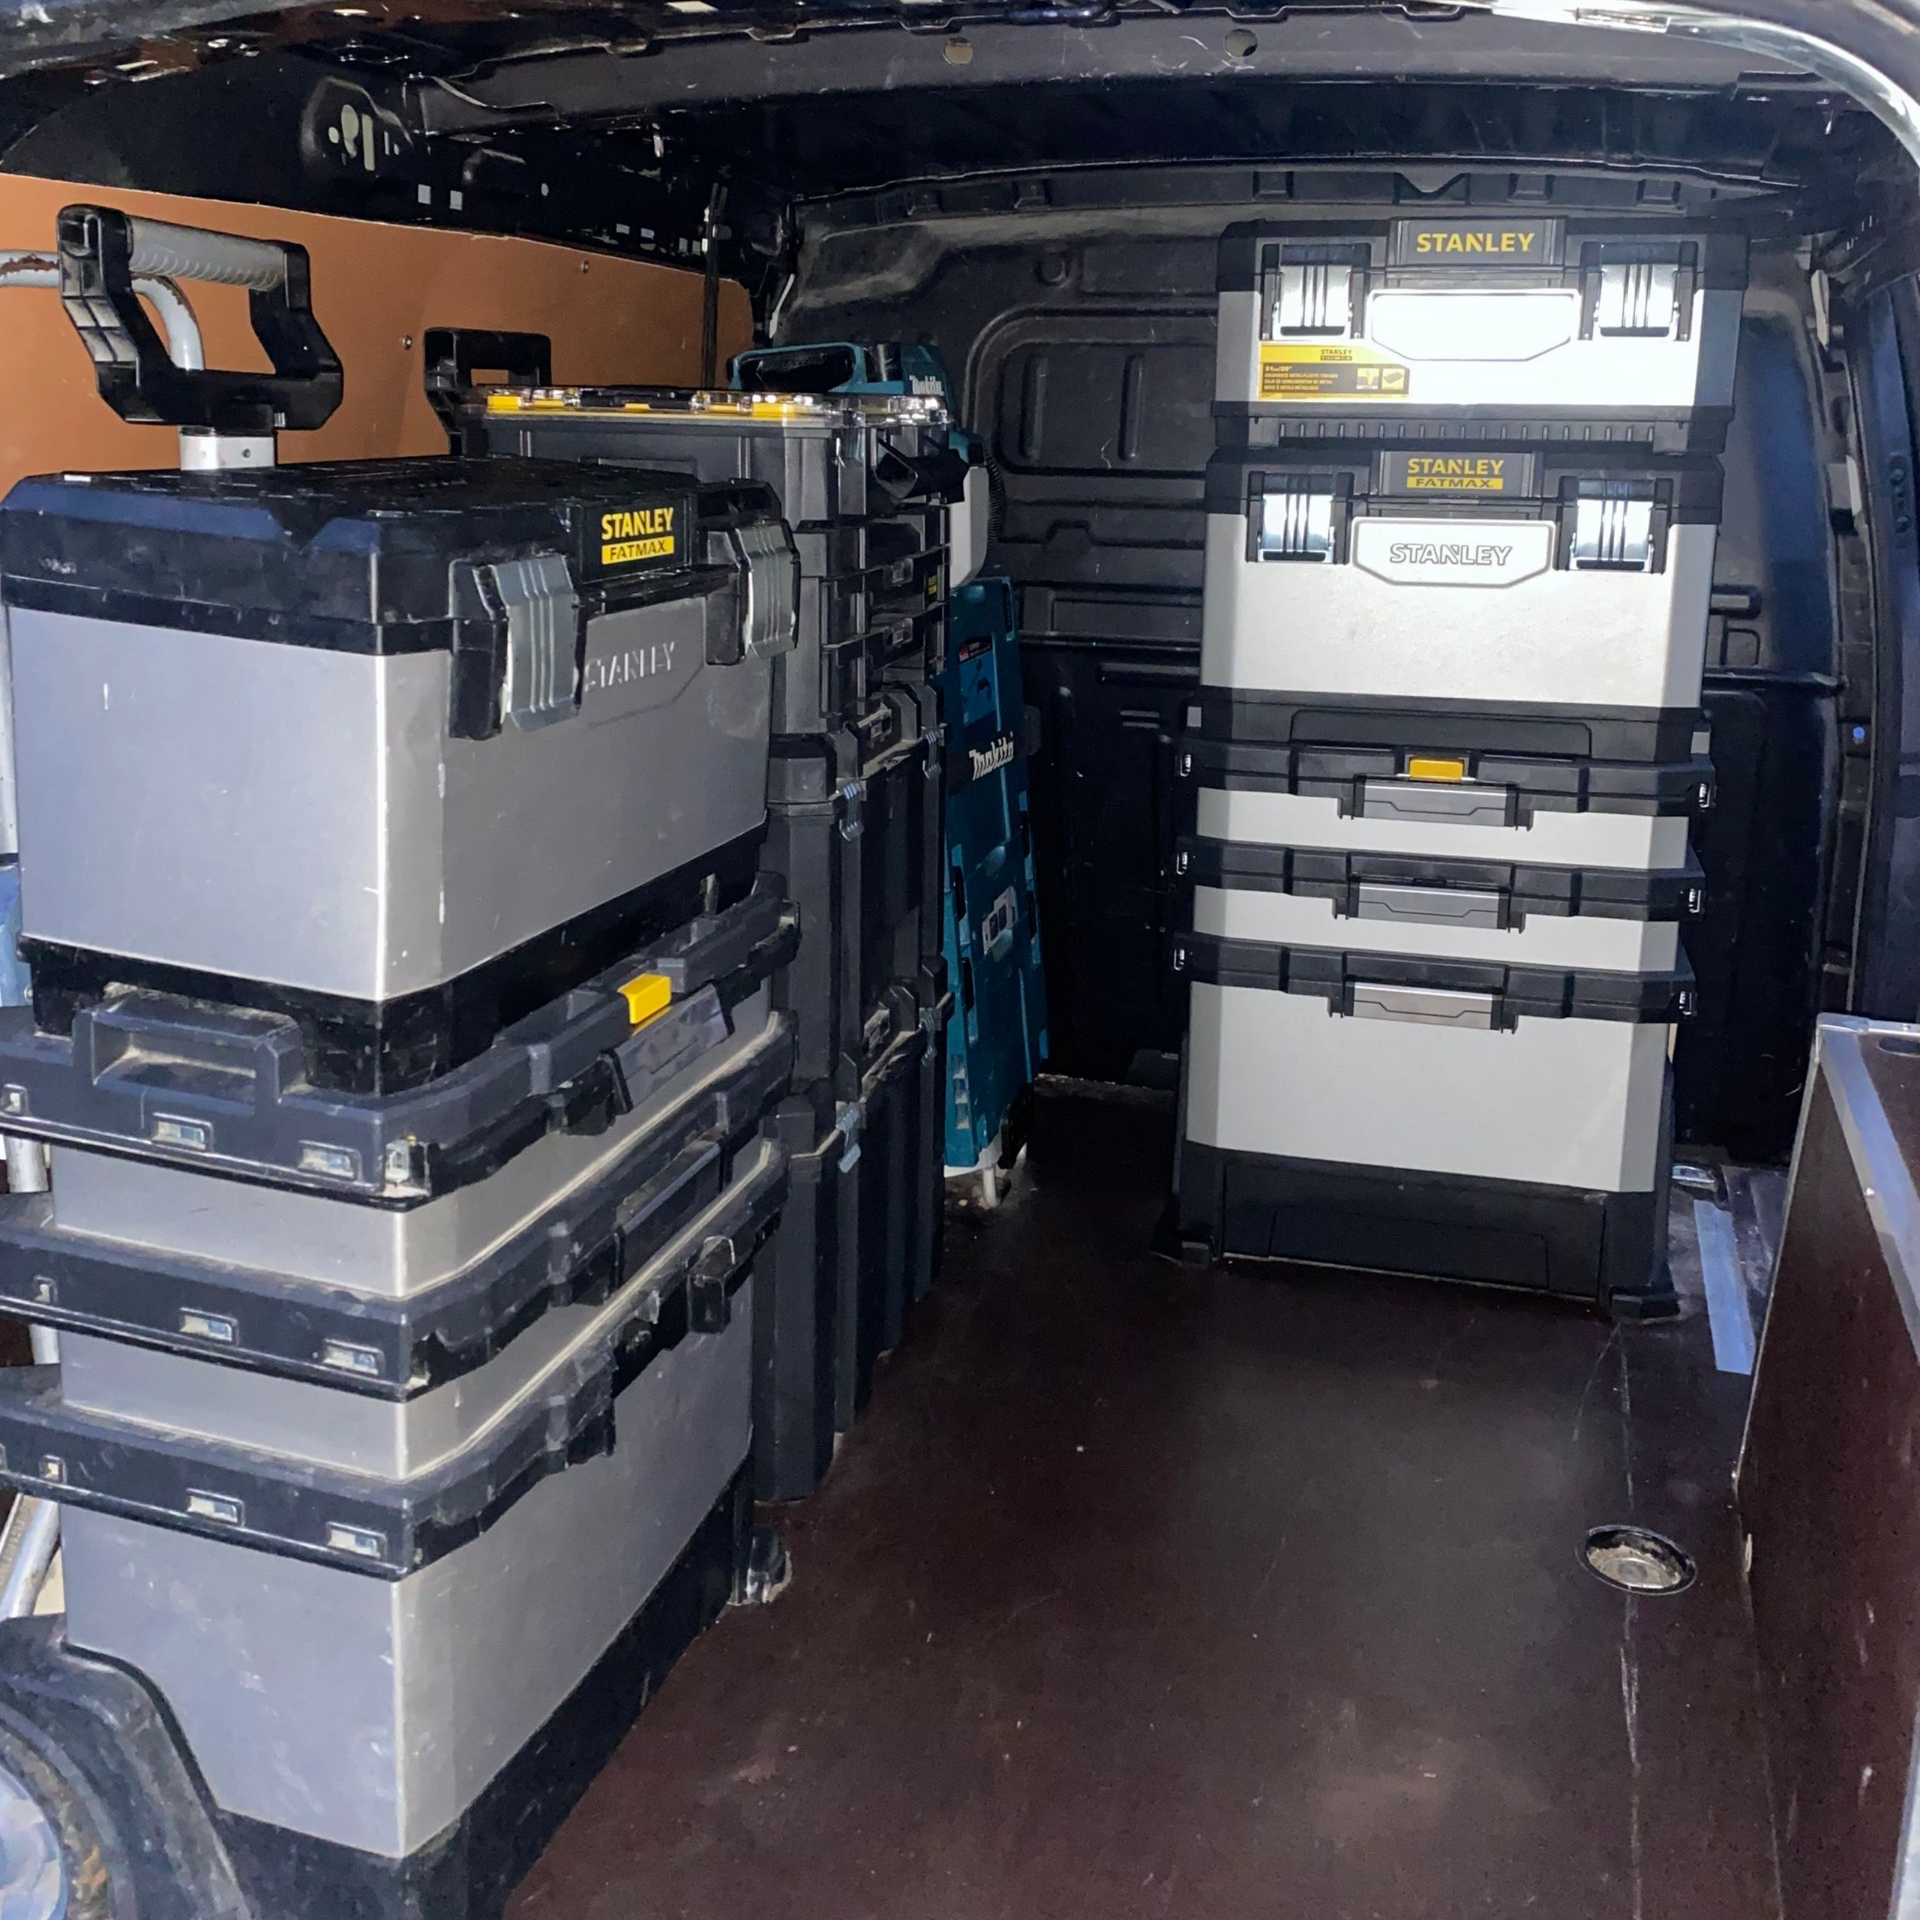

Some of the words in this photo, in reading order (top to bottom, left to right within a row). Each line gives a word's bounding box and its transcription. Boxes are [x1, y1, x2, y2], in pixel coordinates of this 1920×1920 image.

[1416, 231, 1535, 253] STANLEY
[1407, 458, 1505, 476] STANLEY
[1416, 478, 1492, 488] FATMAX
[601, 507, 674, 541] STANLEY
[609, 539, 667, 561] FATMAX
[1389, 542, 1513, 566] STANLEY
